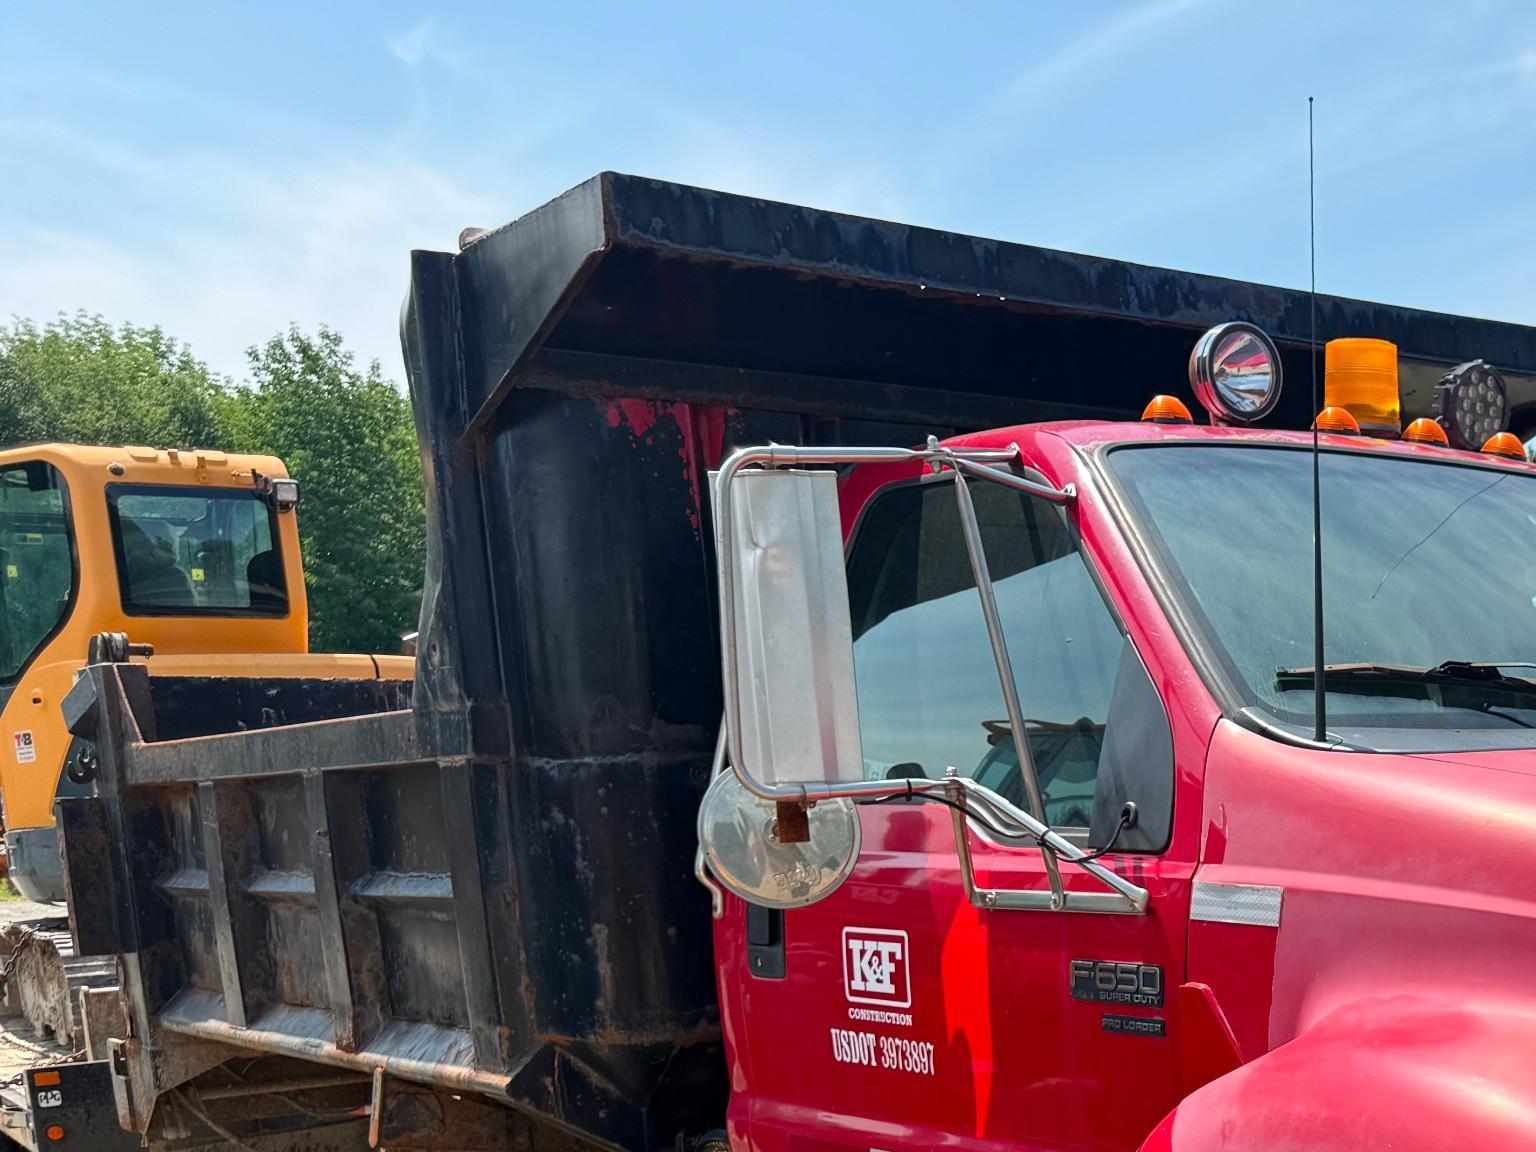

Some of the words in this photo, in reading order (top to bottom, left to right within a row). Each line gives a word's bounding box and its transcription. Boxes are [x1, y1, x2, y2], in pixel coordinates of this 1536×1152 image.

[848, 939, 902, 994] K&F
[1099, 991, 1131, 1003] SUPER
[1133, 994, 1160, 1005] DUTY
[848, 1007, 912, 1026] CONSTRUCTION
[1122, 1020, 1161, 1033] LOADER
[830, 1028, 877, 1067] USDOT
[879, 1035, 935, 1076] 3973897
